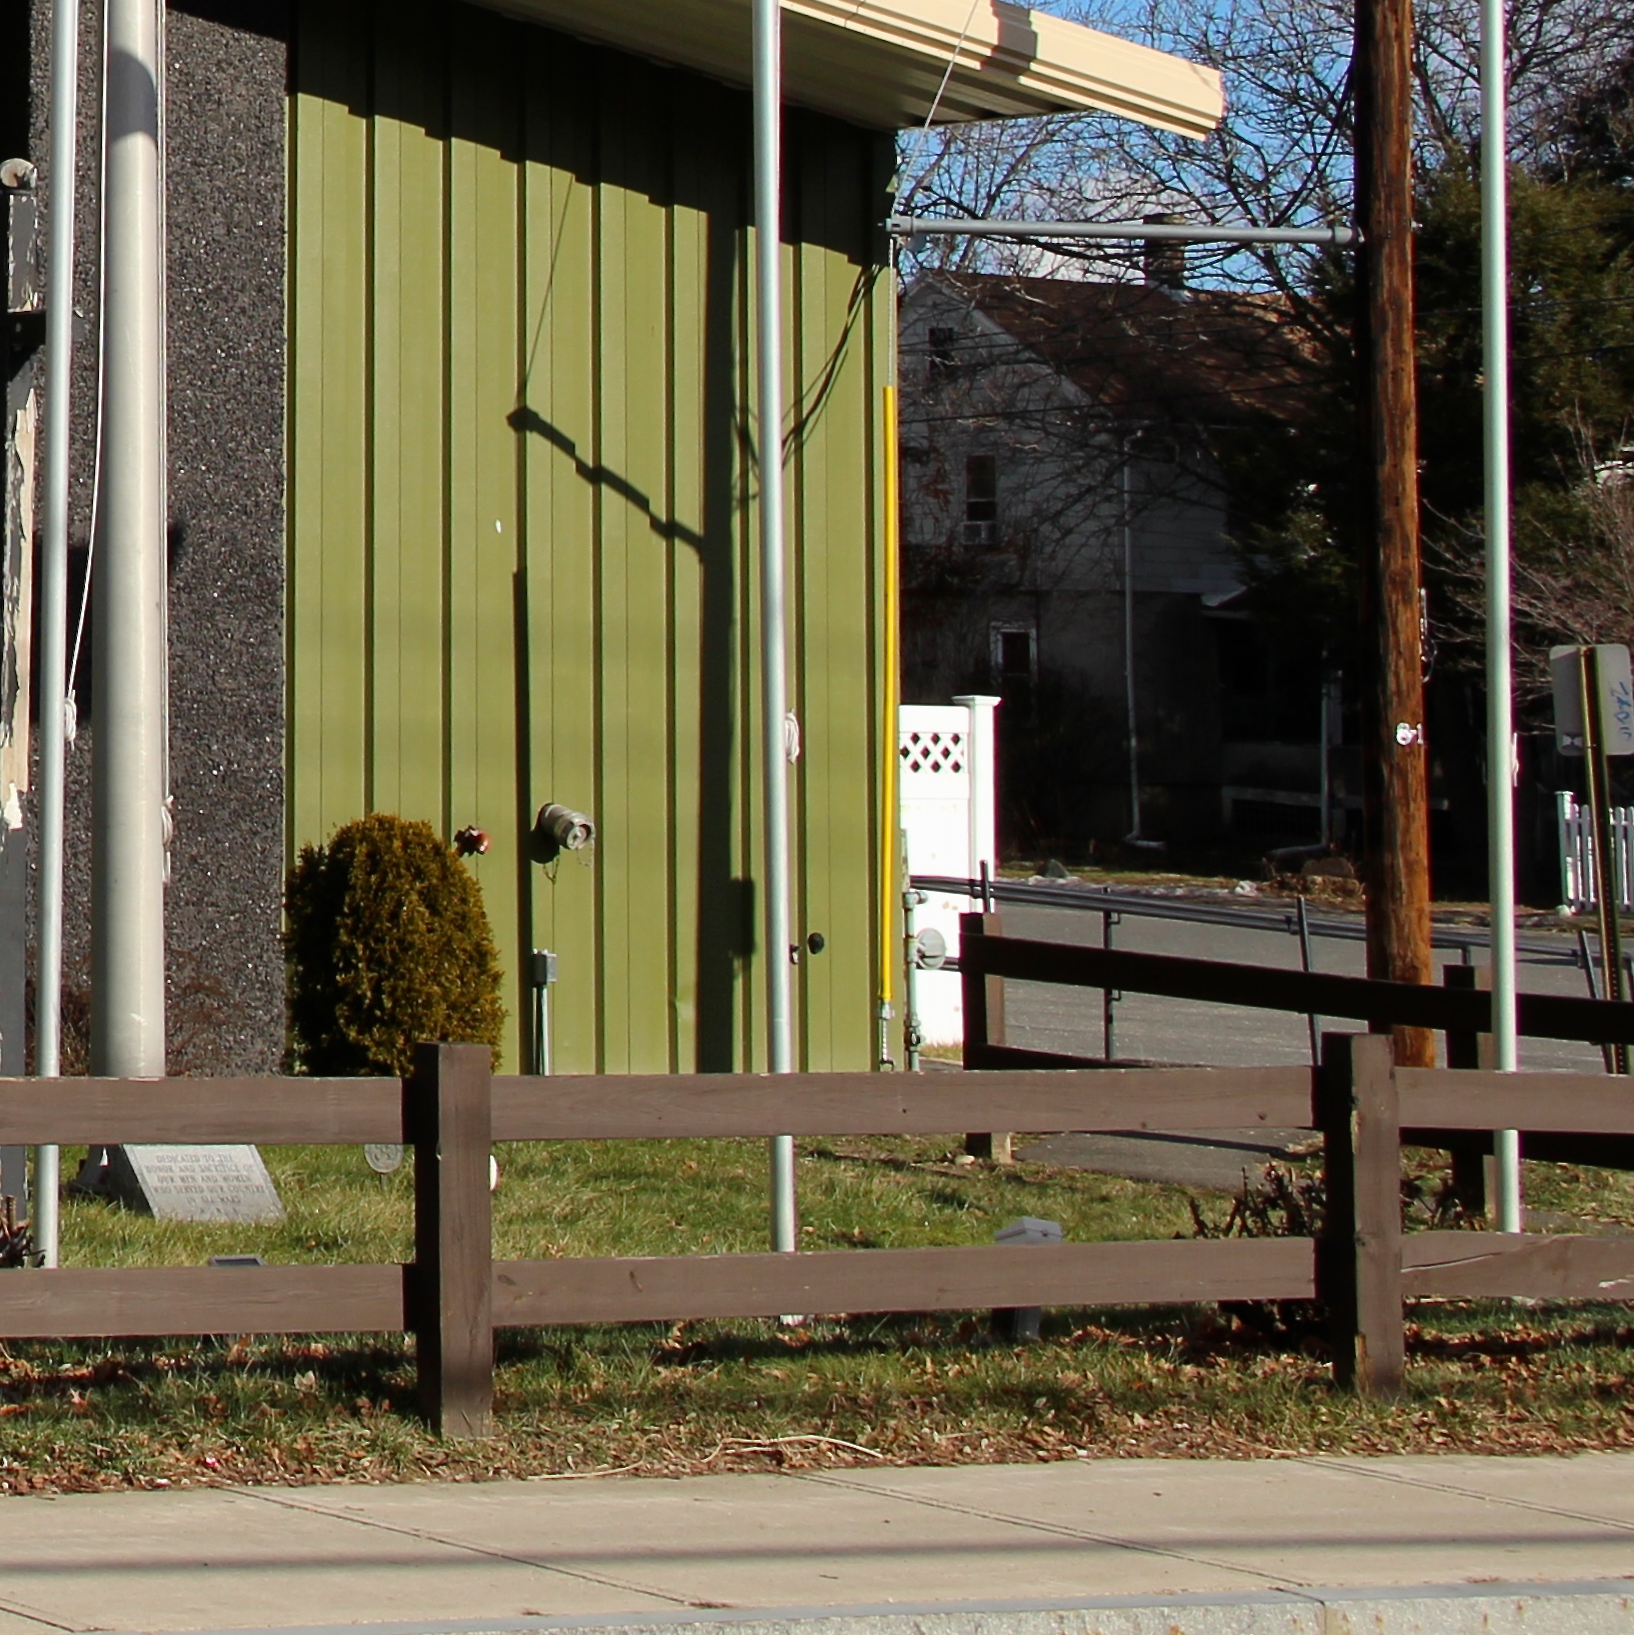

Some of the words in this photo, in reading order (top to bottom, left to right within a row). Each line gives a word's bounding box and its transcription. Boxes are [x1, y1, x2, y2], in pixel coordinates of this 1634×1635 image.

[155, 1154, 200, 1163] DEDICATED
[204, 1154, 215, 1163] TO
[218, 1154, 234, 1163] THE
[146, 1165, 174, 1173] HONOR
[179, 1164, 195, 1173] AND
[200, 1164, 241, 1173] SACRIFICE
[244, 1164, 254, 1173] OF
[157, 1175, 174, 1184] OUR
[180, 1175, 196, 1184] MEN
[201, 1175, 217, 1184] AND
[222, 1175, 251, 1184] WOMEN
[153, 1185, 172, 1194] WHO
[176, 1185, 204, 1194] SERVED
[207, 1185, 224, 1194] OUR
[227, 1185, 265, 1194] COUNTRY
[201, 1195, 214, 1204] ALL
[219, 1195, 241, 1204] WARS
